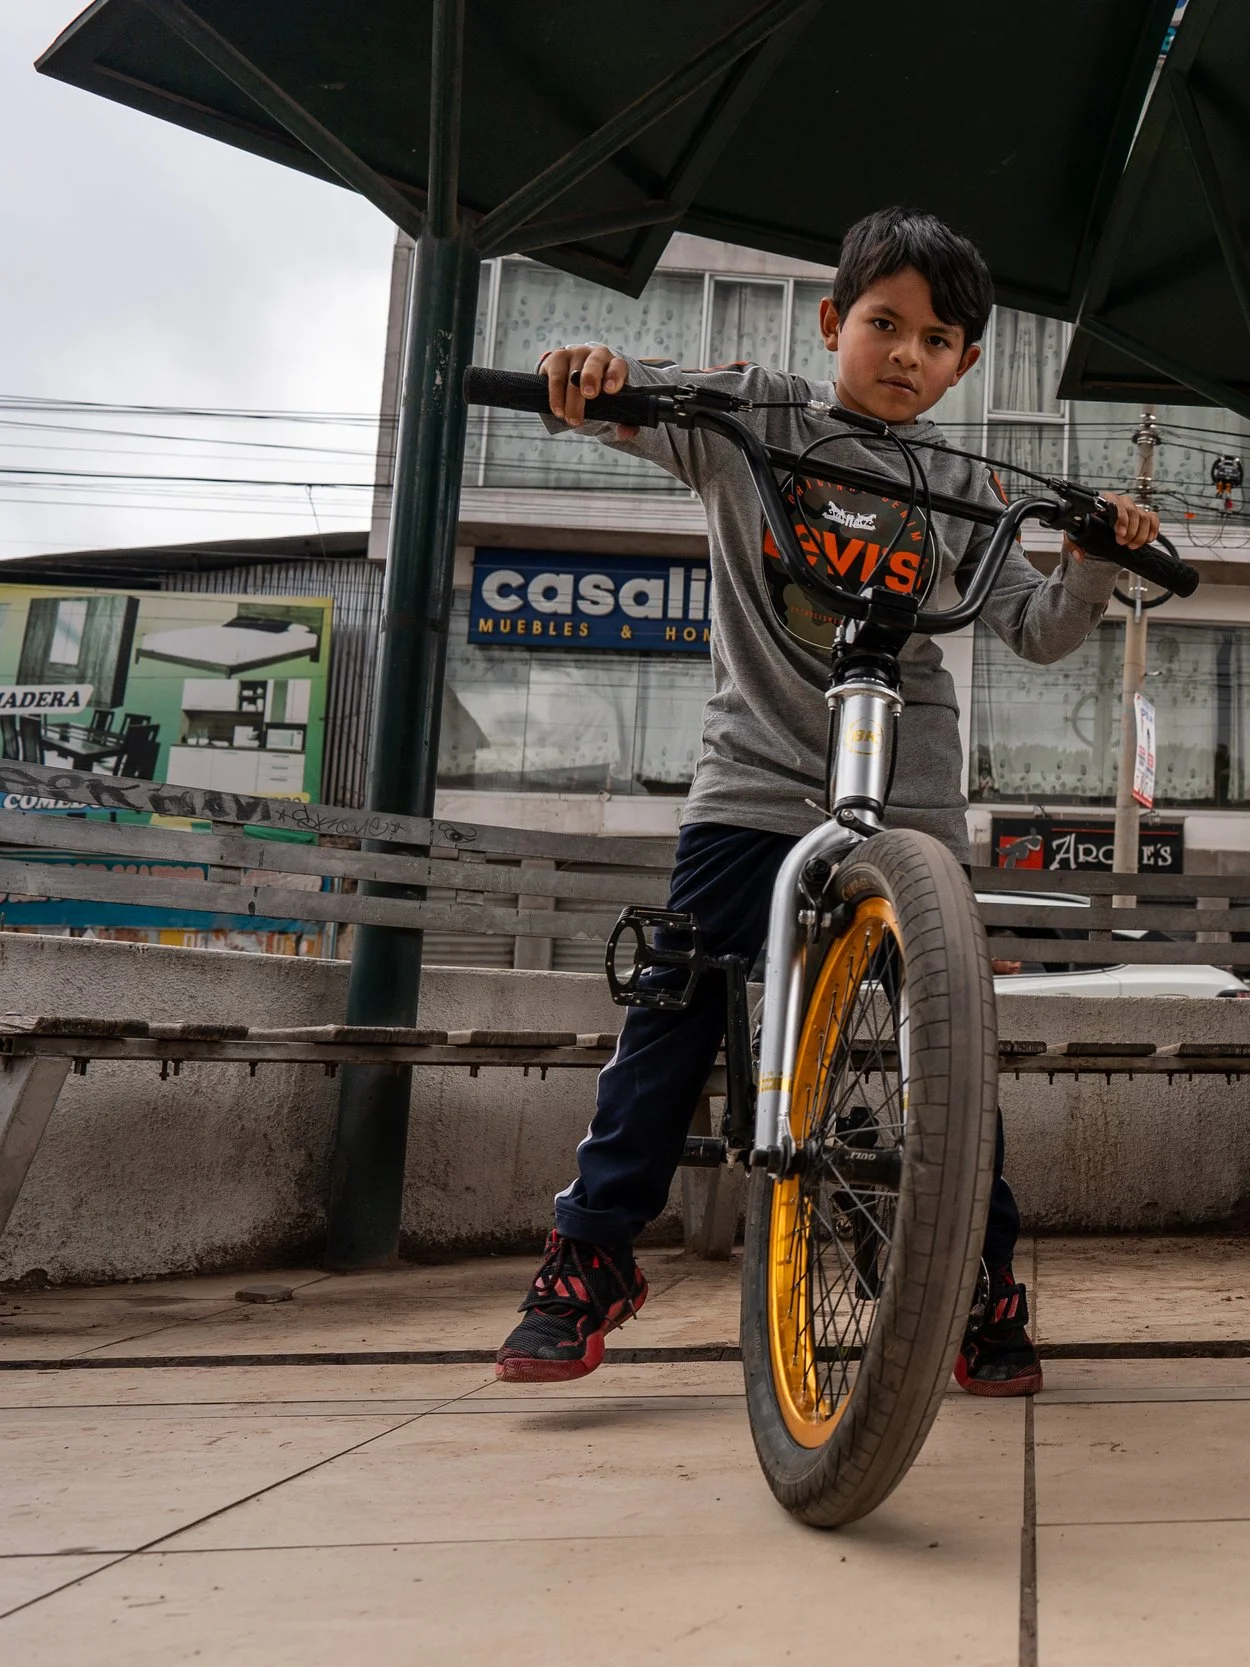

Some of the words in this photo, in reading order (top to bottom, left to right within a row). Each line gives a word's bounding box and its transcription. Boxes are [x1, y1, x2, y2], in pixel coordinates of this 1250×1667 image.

[482, 567, 712, 621] casali
[478, 618, 588, 637] MUEBLES
[620, 624, 632, 640] &
[0, 690, 81, 709] ADERA
